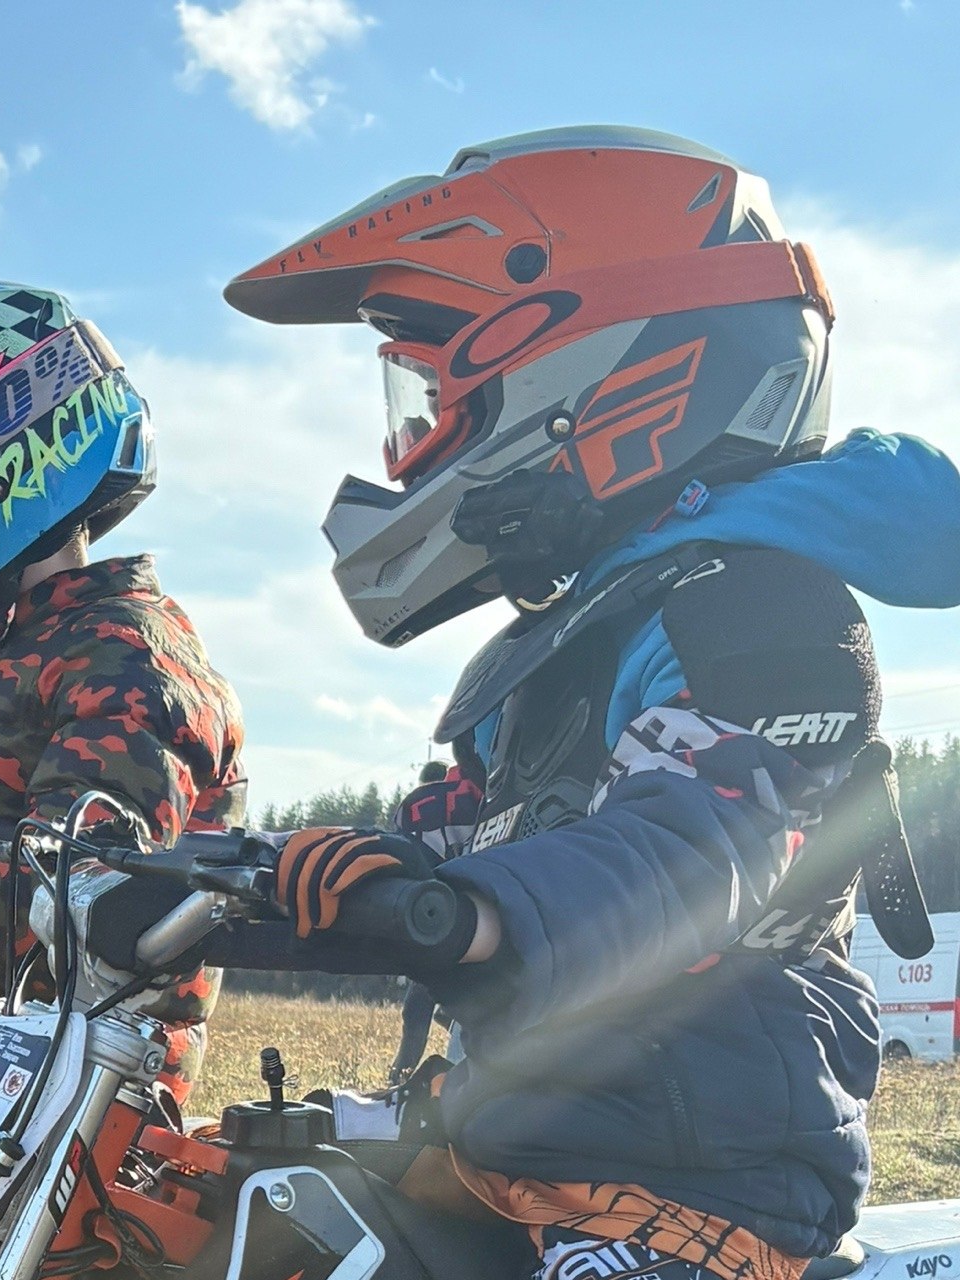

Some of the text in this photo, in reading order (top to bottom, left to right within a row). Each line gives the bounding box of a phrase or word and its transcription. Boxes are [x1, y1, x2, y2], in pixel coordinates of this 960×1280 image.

[279, 185, 452, 273] FLY RACING
[657, 565, 679, 582] OPEN
[750, 711, 858, 747] LEATT
[908, 963, 933, 984] 103
[905, 1254, 953, 1279] KAYO
